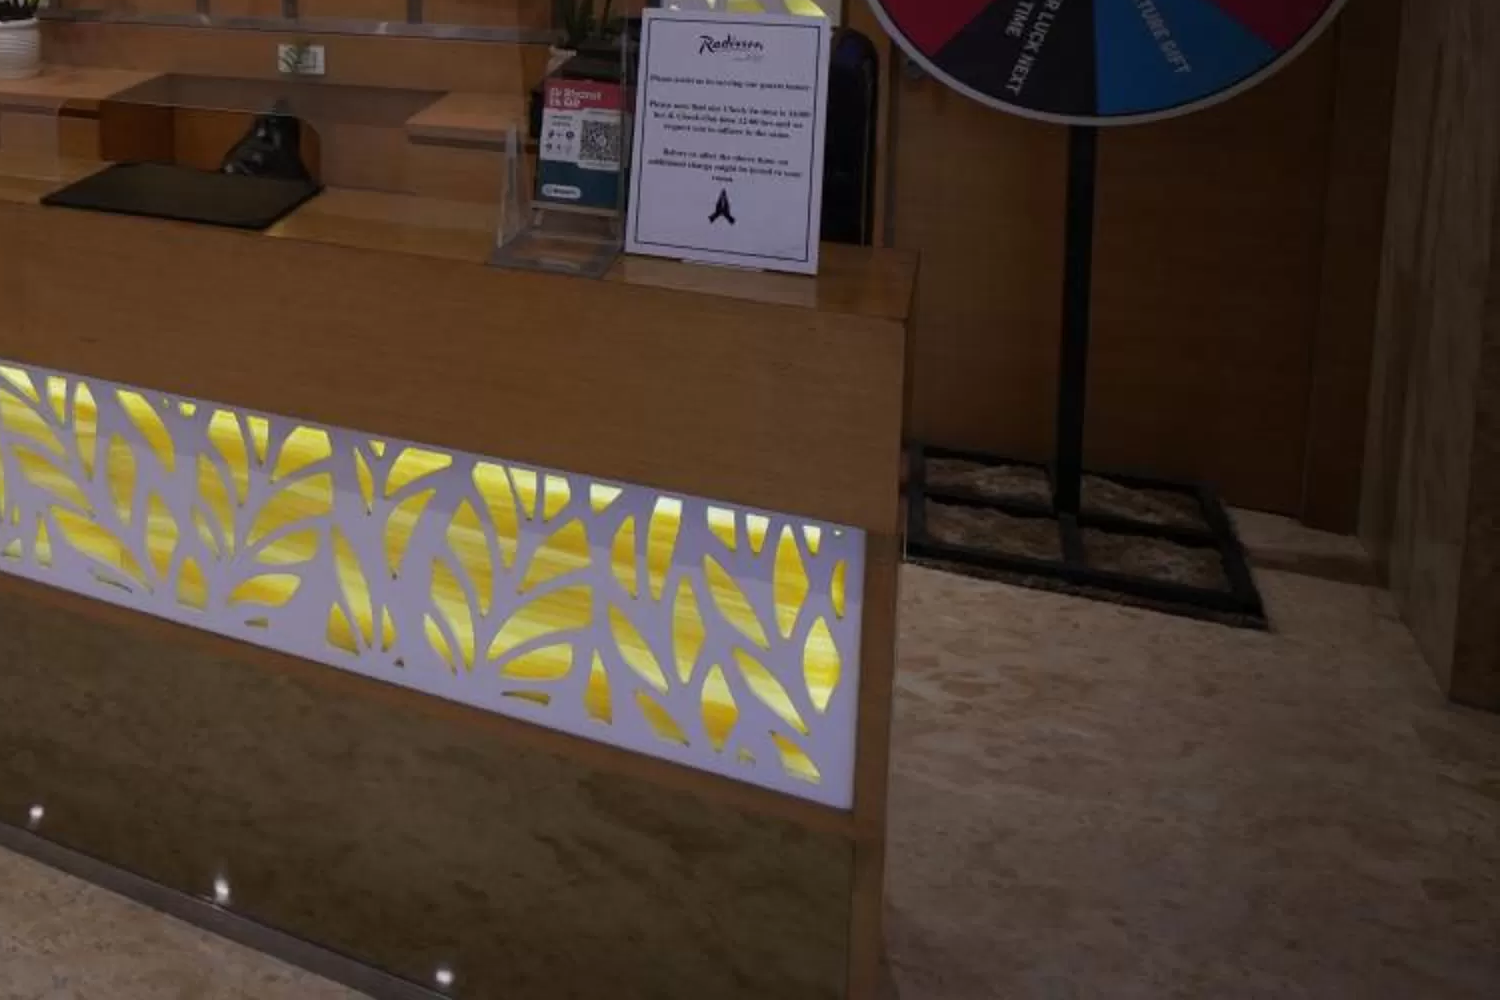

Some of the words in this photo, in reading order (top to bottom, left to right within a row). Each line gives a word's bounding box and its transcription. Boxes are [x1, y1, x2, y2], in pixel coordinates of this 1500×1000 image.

[1005, 1, 1034, 38] TIME
[1023, 11, 1055, 53] LUCK
[1005, 52, 1036, 96] NEXT
[1161, 39, 1192, 73] GIFT
